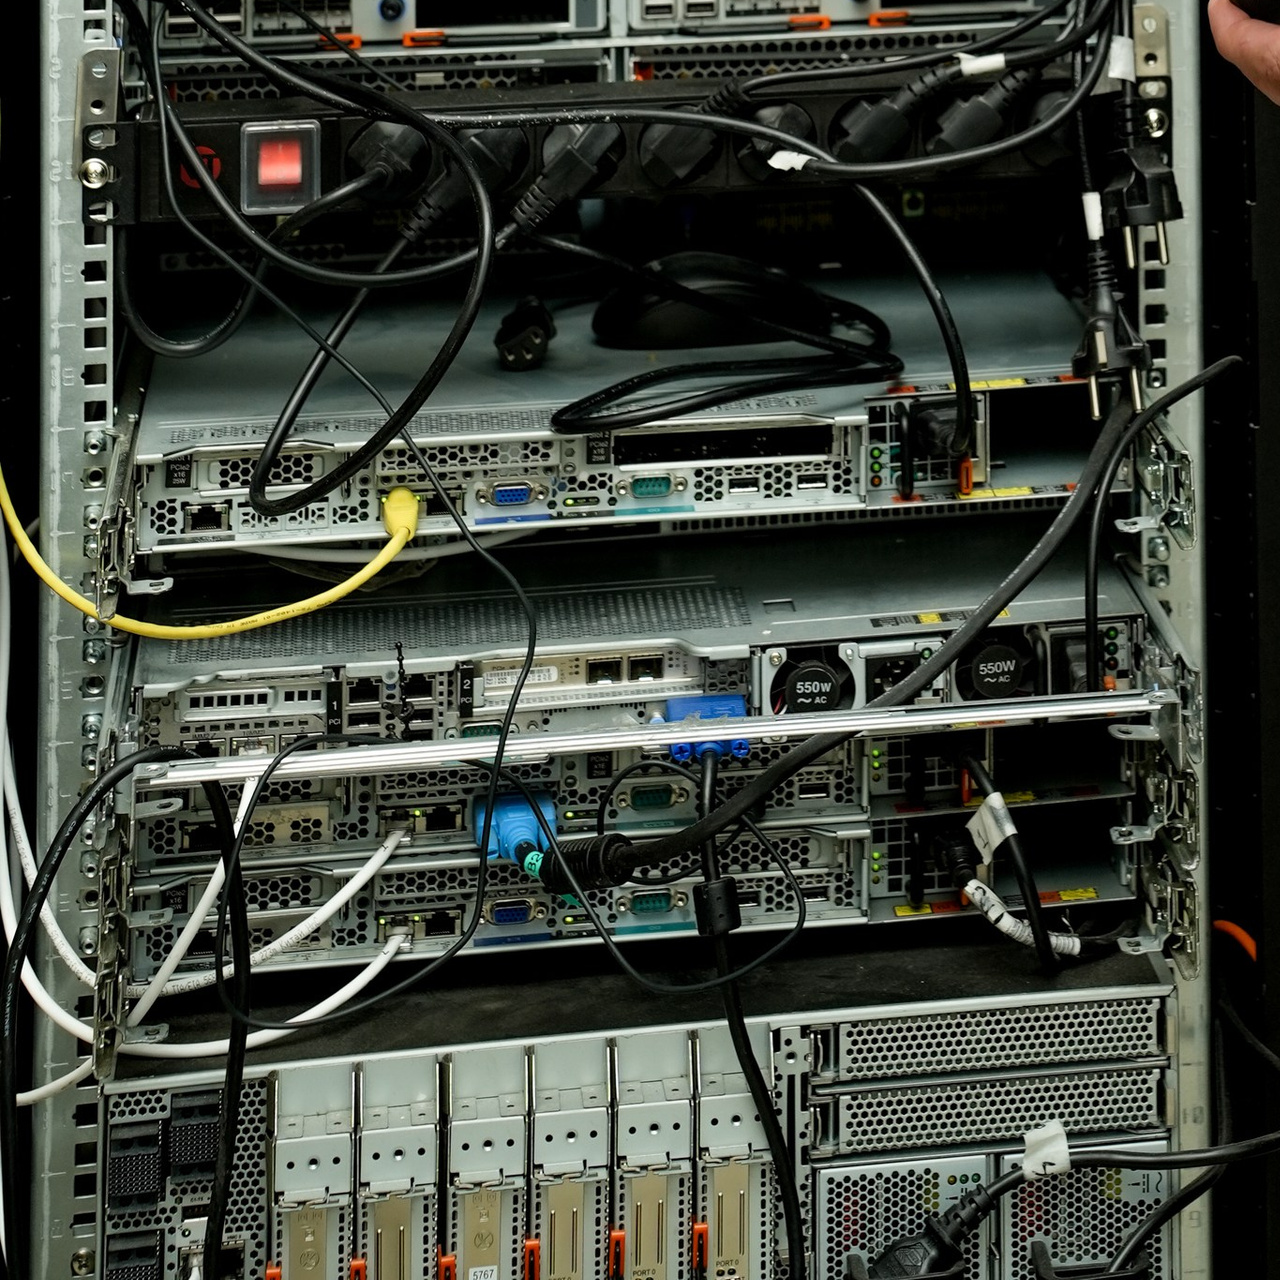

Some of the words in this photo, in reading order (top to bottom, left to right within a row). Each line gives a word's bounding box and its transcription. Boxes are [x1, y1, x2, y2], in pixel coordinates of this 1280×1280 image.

[170, 463, 191, 472] PCIe2
[171, 478, 187, 486] 25W
[978, 659, 1017, 676] 550W
[997, 674, 1011, 683] AC
[463, 679, 471, 689] 2
[795, 681, 832, 694] 550W
[460, 696, 473, 705] PCI
[814, 695, 828, 705] AC
[332, 700, 338, 711] 1
[328, 717, 341, 726] PCI
[169, 897, 182, 905] x16
[171, 977, 201, 995] TIA/EIA
[279, 929, 306, 952] Китай
[733, 1258, 740, 1266] 0
[473, 1269, 495, 1280] 5767
